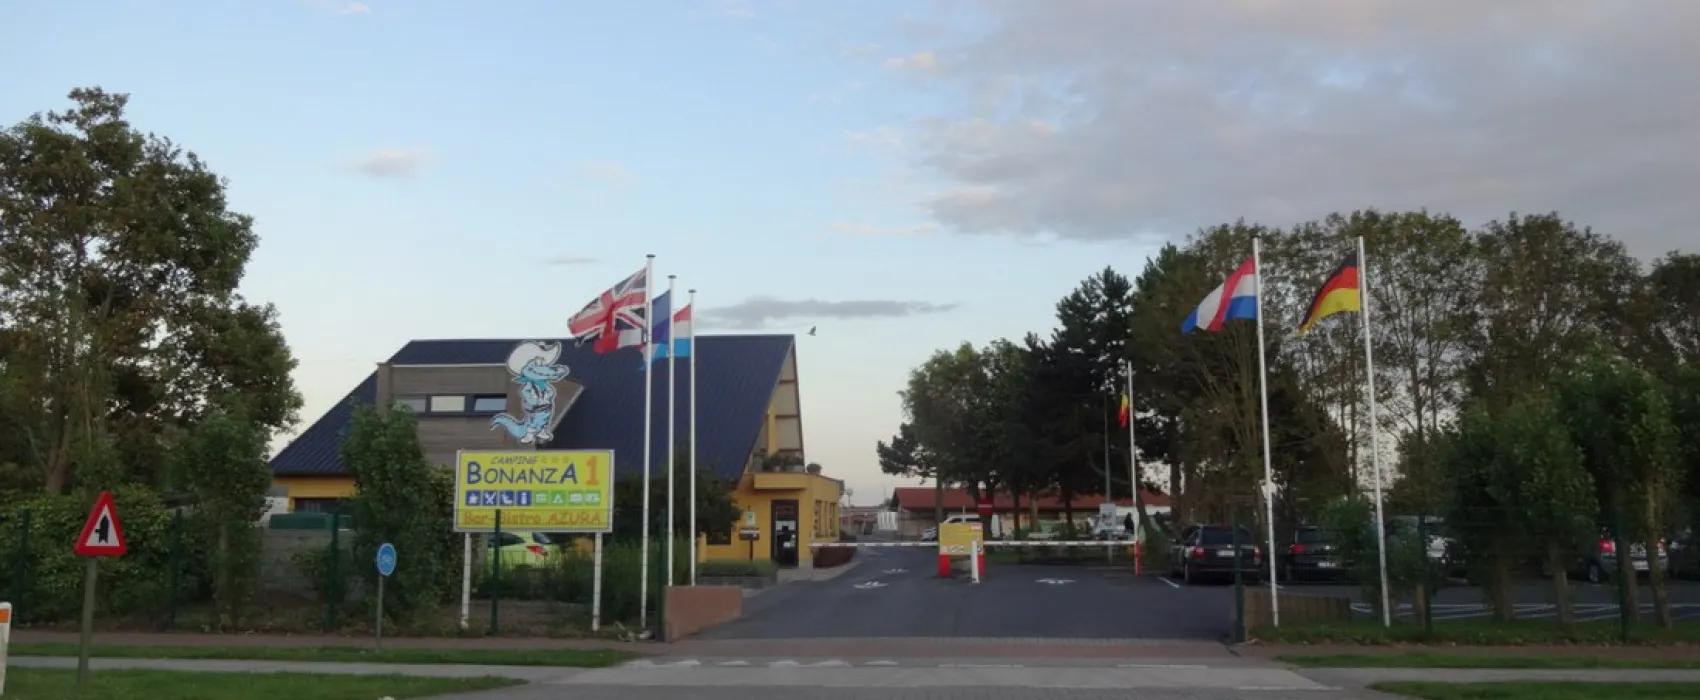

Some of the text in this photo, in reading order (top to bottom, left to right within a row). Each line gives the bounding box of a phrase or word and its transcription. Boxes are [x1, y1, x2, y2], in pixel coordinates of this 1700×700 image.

[490, 455, 538, 465] CAMPING
[467, 455, 600, 486] BONANZA 1
[544, 511, 602, 526] AZURA
